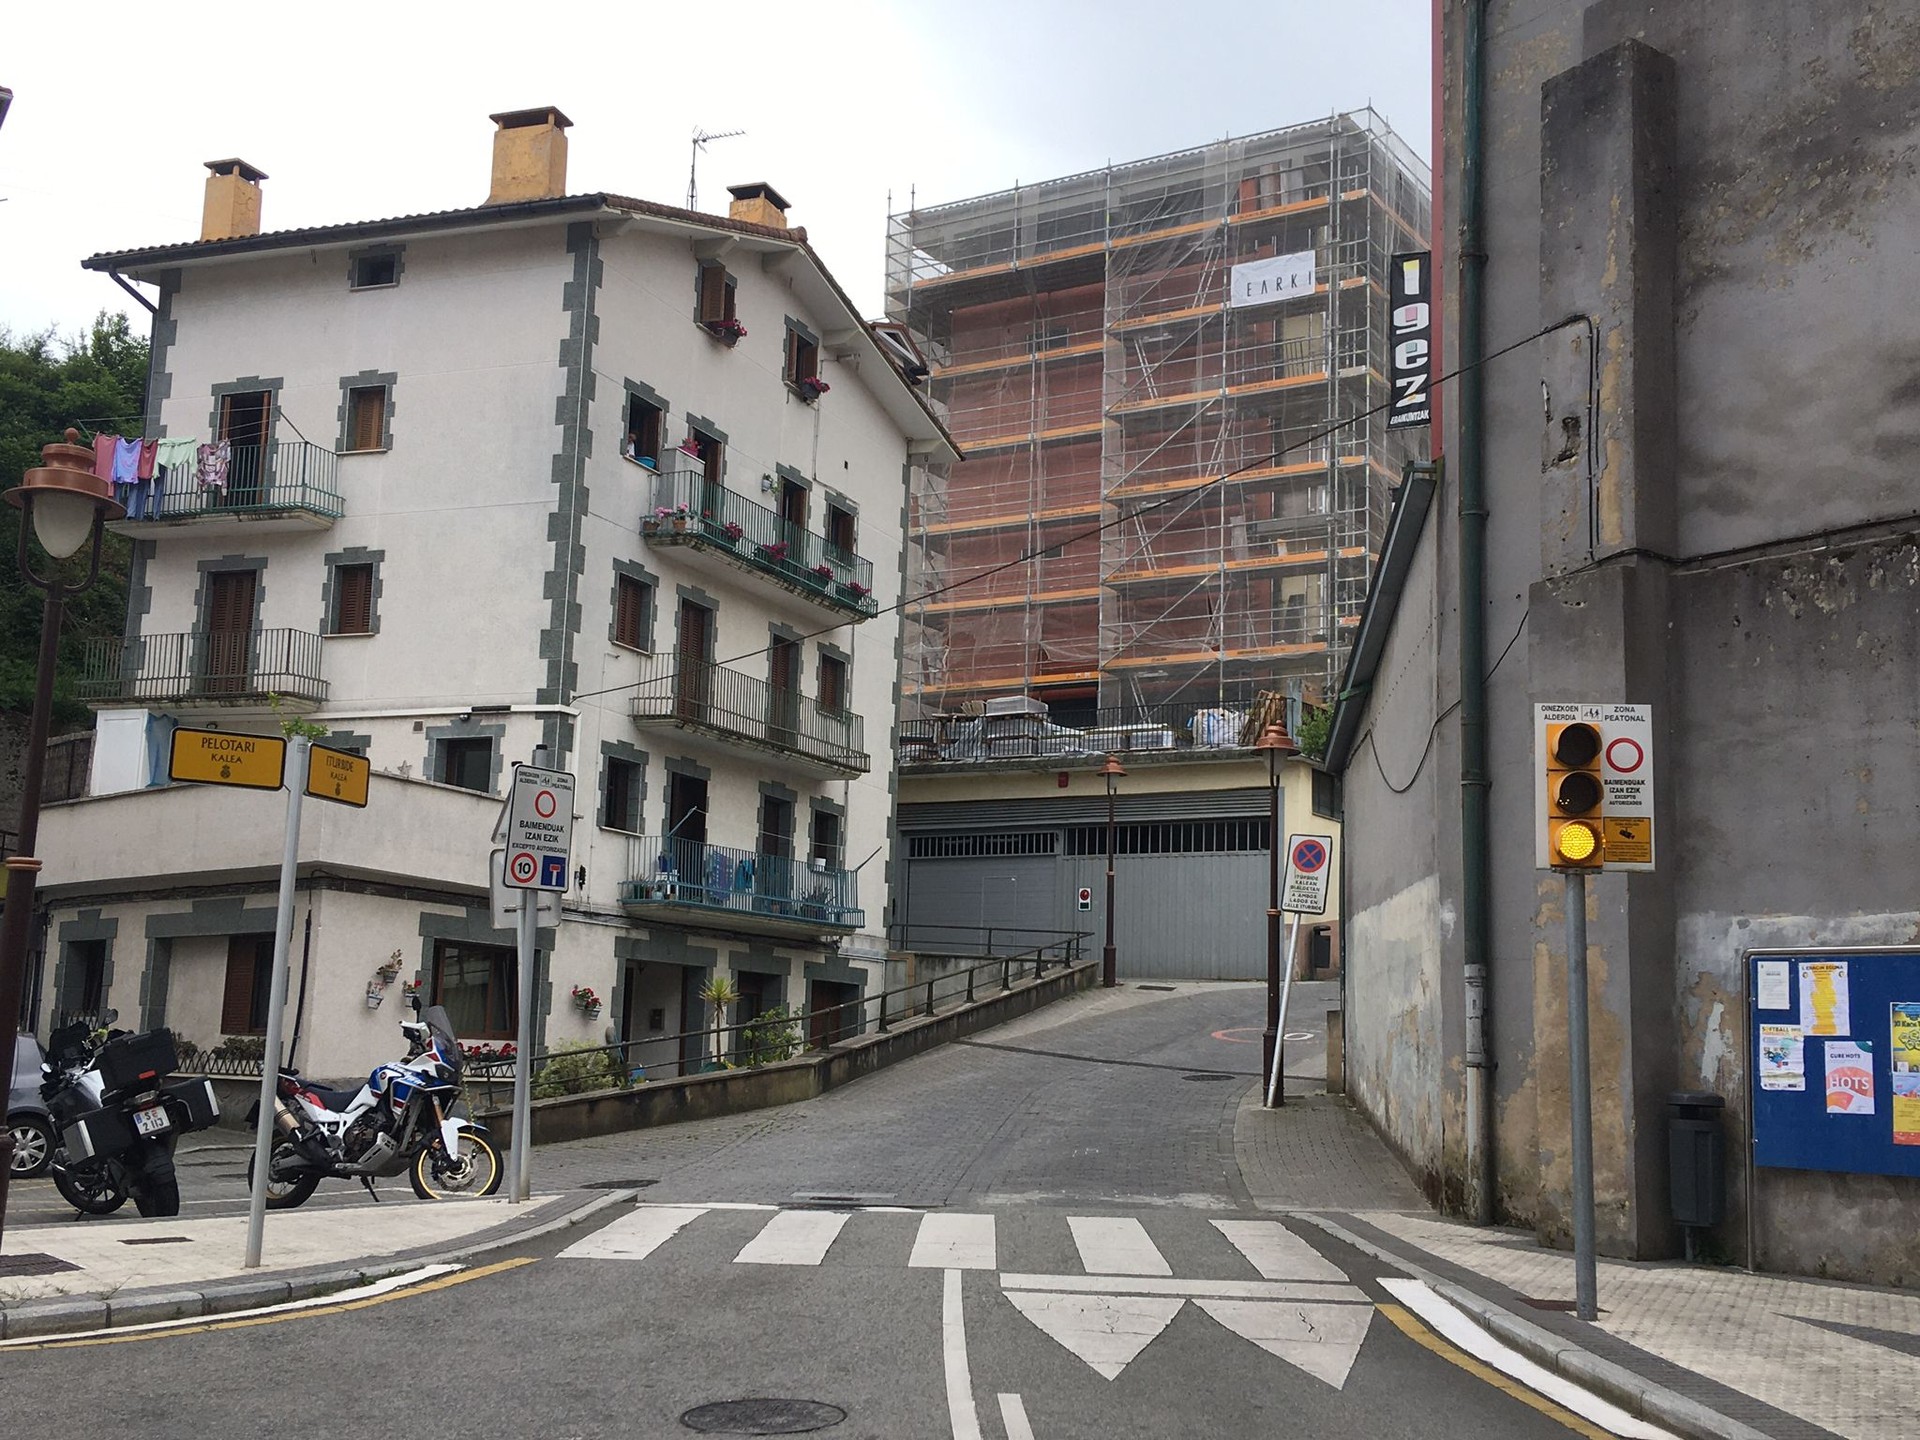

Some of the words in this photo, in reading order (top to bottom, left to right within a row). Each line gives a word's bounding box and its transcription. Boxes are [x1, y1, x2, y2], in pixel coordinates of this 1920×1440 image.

[1246, 271, 1312, 297] EARKI
[1543, 713, 1577, 721] ALDERDIA
[201, 737, 256, 753] PELOTARI
[211, 753, 243, 764] KALEA
[330, 771, 348, 782] KALEA
[519, 820, 565, 833] BAIMENDUAK
[525, 832, 542, 842] IZAN
[543, 834, 559, 843] EZIK
[512, 842, 536, 851] EXCEPTO
[517, 862, 531, 875] 10
[1830, 1073, 1870, 1090] HOTS
